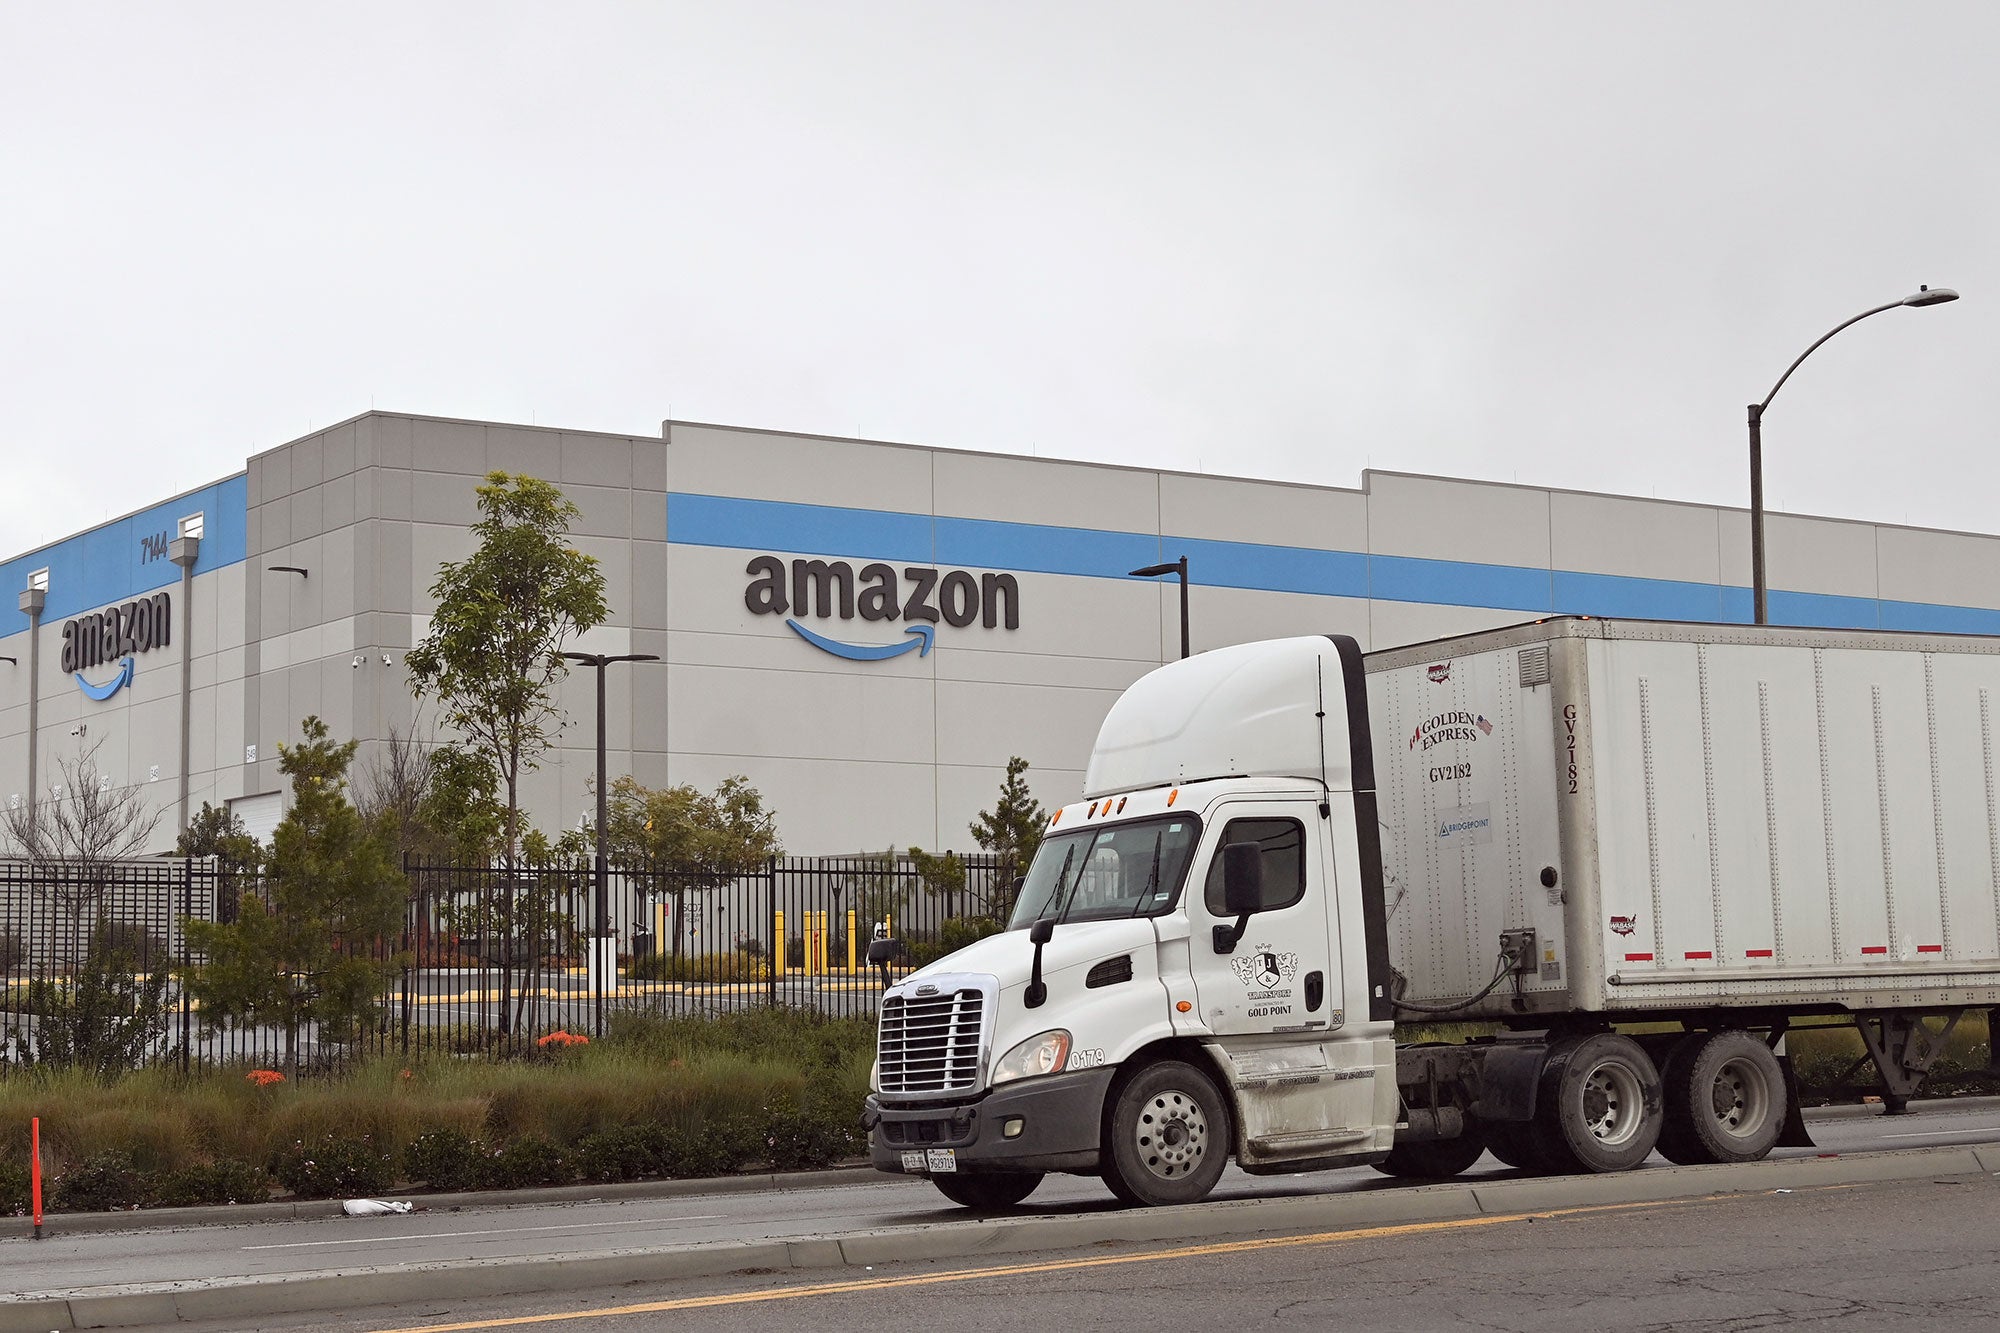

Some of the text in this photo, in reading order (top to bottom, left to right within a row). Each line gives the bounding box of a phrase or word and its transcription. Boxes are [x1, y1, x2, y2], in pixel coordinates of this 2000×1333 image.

[141, 531, 167, 565] 7144
[745, 555, 1020, 630] amazon
[61, 592, 171, 673] amazon
[1422, 711, 1475, 734] GOLDEN
[1422, 727, 1477, 751] EXPRESS
[1563, 704, 1578, 794] GV2182
[1429, 762, 1471, 783] GV2182
[1449, 818, 1489, 832] BRIDGEPOINT
[1257, 958, 1271, 969] T J
[1247, 989, 1292, 1000] TRANSPORT
[1248, 1005, 1292, 1017] GOLD POINT
[1071, 1047, 1106, 1069] 0179
